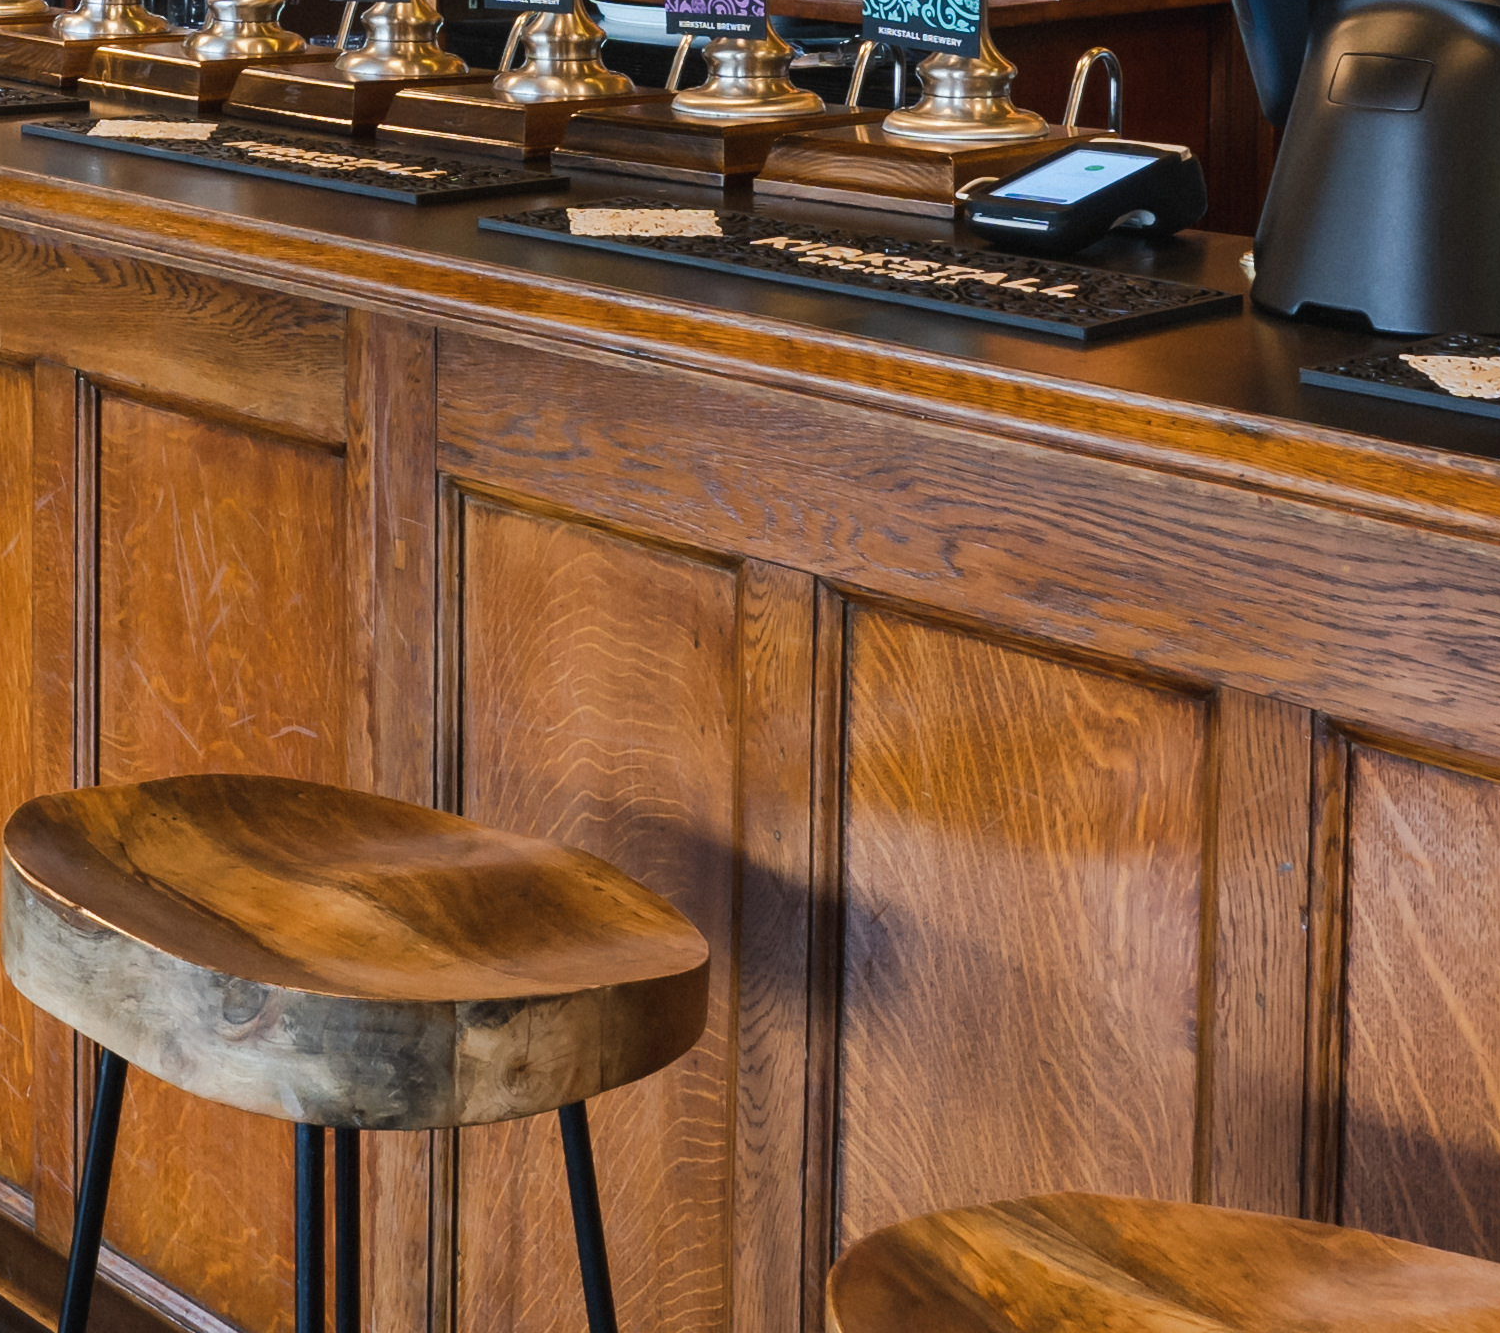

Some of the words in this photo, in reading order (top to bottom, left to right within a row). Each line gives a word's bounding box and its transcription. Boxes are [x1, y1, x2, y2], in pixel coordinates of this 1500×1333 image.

[678, 19, 716, 31] KIRKSTALL
[716, 21, 751, 32] BREWERY
[877, 26, 921, 41] KIRKSTALL
[922, 33, 963, 47] BREWERY
[749, 235, 1080, 298] KIRKSTALL
